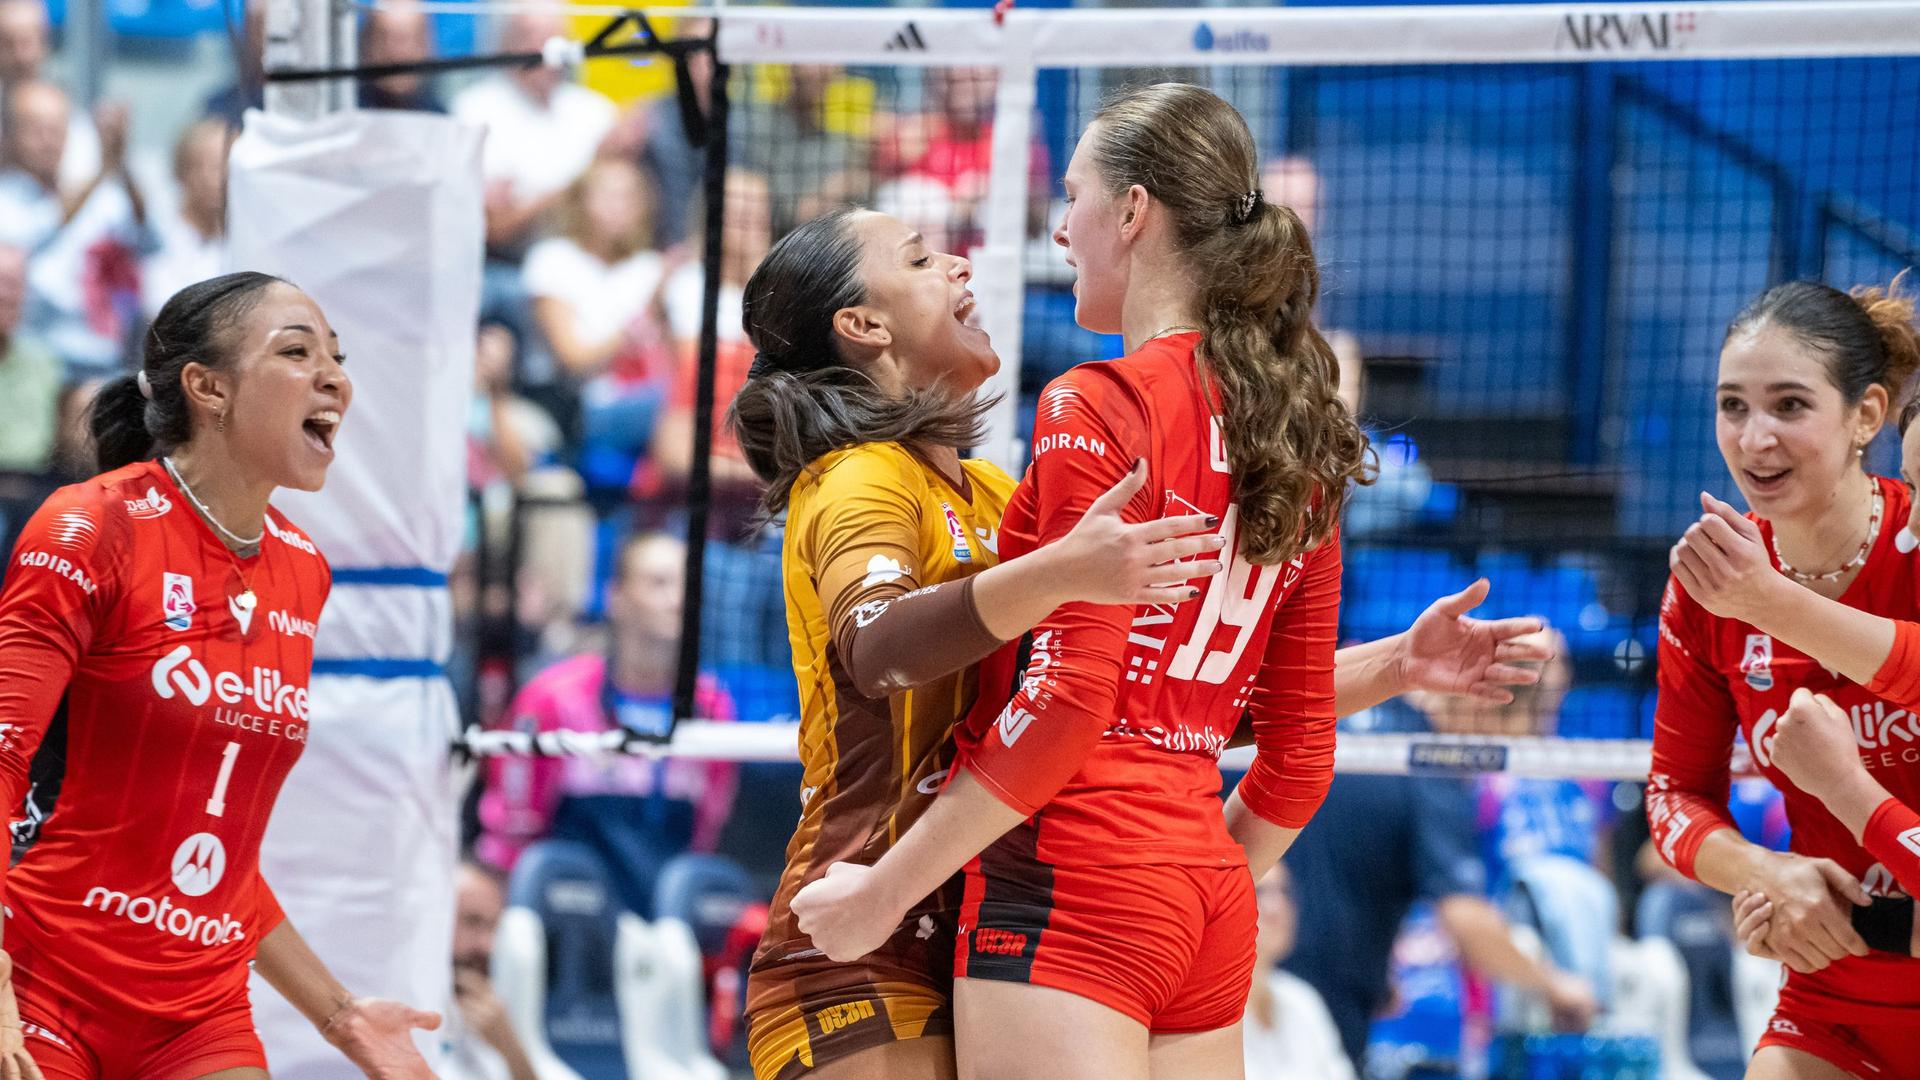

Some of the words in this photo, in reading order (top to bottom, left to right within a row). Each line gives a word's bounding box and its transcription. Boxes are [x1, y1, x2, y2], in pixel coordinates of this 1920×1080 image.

[1032, 432, 1106, 463] ADIRAN
[214, 706, 264, 734] LUCE
[267, 719, 282, 737] E
[284, 723, 308, 746] GA
[1850, 700, 1920, 750] lik
[204, 740, 242, 818] 1
[82, 886, 246, 947] motorola
